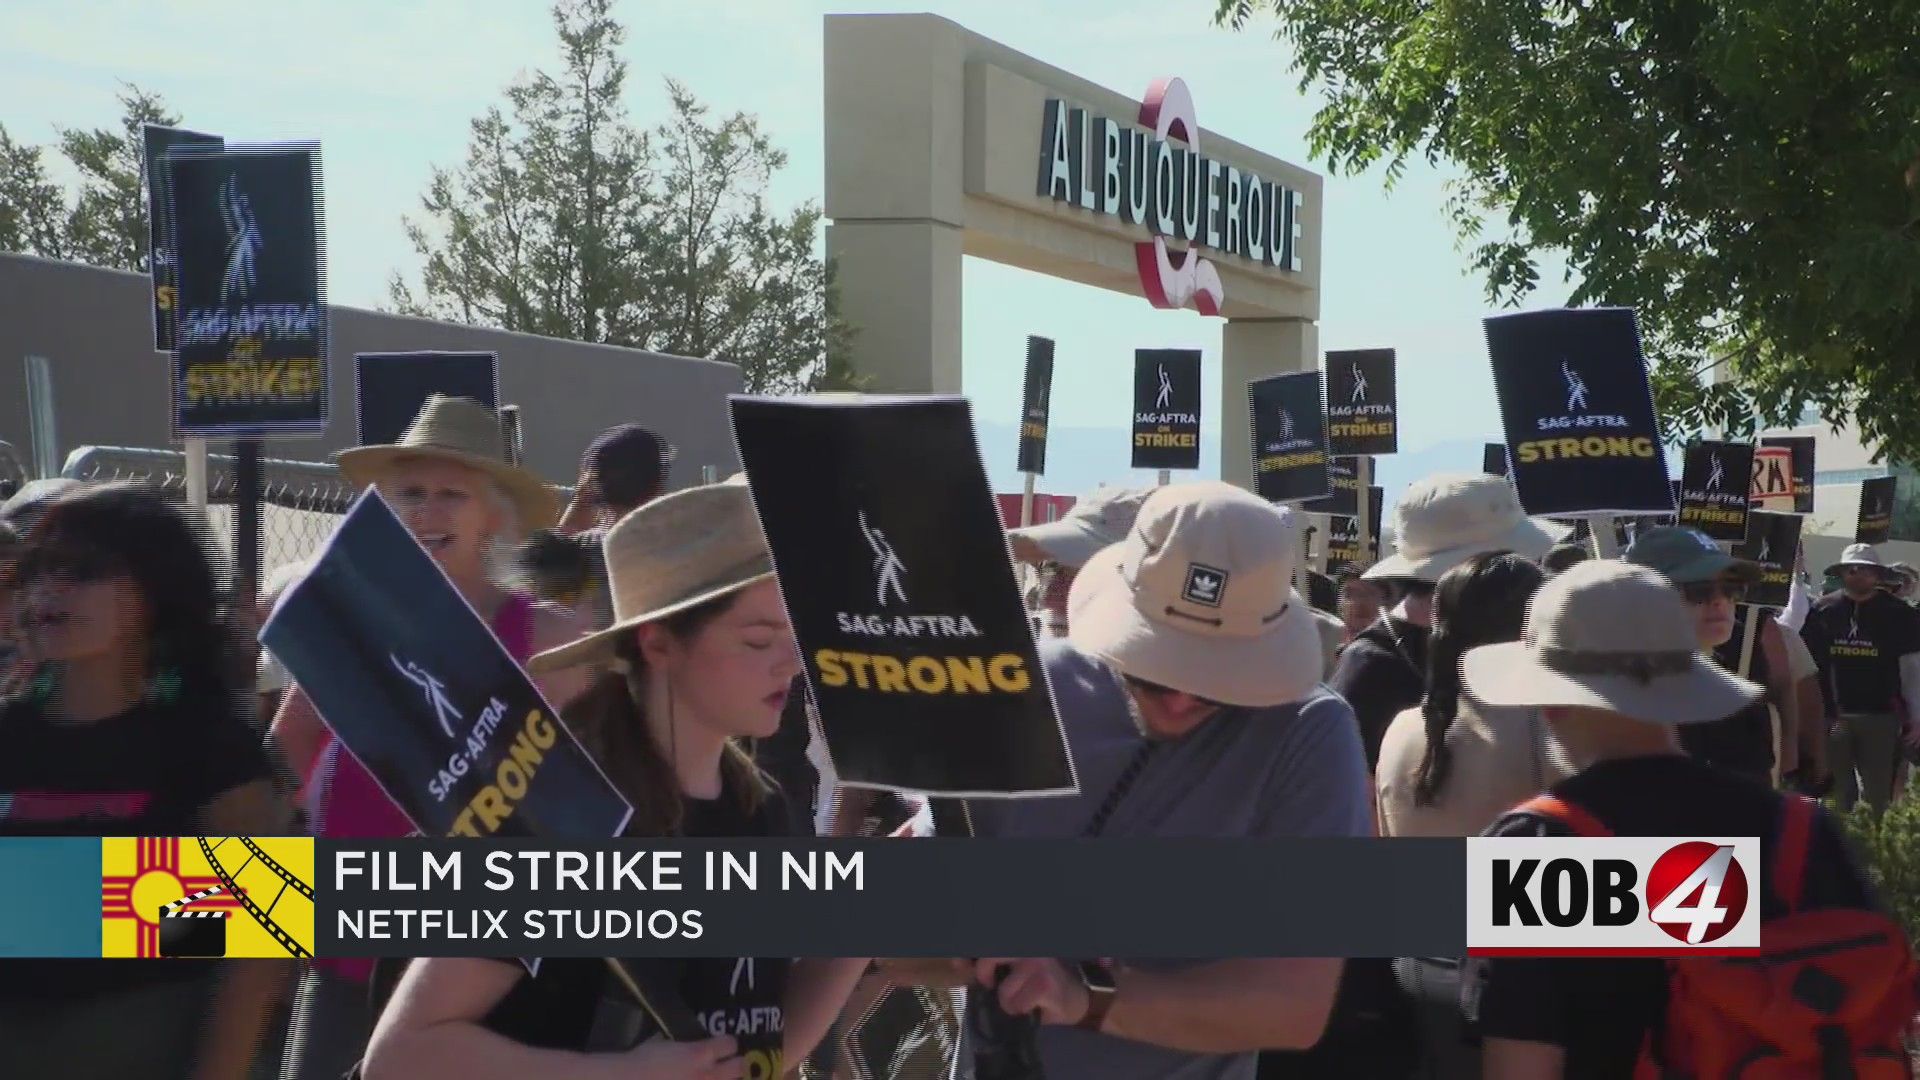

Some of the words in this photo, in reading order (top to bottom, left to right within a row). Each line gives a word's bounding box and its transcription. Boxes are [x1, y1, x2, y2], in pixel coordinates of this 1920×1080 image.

[1041, 100, 1303, 272] ALBUQUERQUE
[181, 357, 321, 407] STRIKE!
[1134, 433, 1197, 447] STRIKE!
[1330, 422, 1393, 437] STRIKE!
[1517, 435, 1655, 463] STRONG
[1682, 504, 1745, 524] STRIKE!
[1830, 646, 1879, 657] STRONG
[815, 648, 1032, 694] STRONG
[448, 708, 557, 837] TRONG
